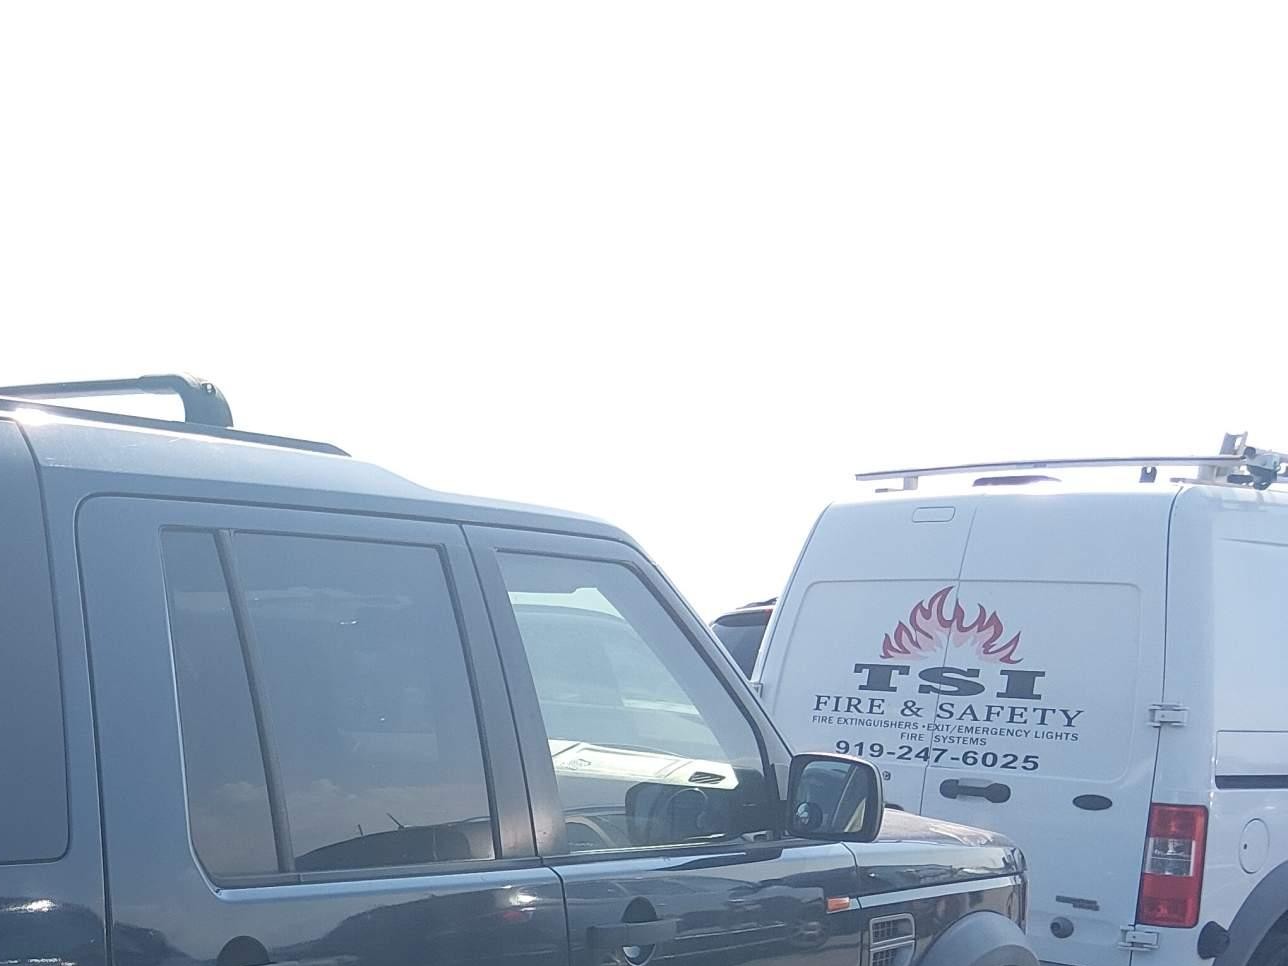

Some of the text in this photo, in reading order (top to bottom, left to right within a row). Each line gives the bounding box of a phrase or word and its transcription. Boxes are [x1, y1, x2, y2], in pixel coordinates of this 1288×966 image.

[854, 663, 1046, 700] TSI
[813, 694, 1085, 728] FIRE & SAFETY
[812, 715, 1079, 742] FIRE EXTINGUISHERS EXIT/EMERGENCY LIGHTS
[900, 732, 987, 746] FIRE SYSTEMS
[835, 740, 1040, 771] 919-247-6025
